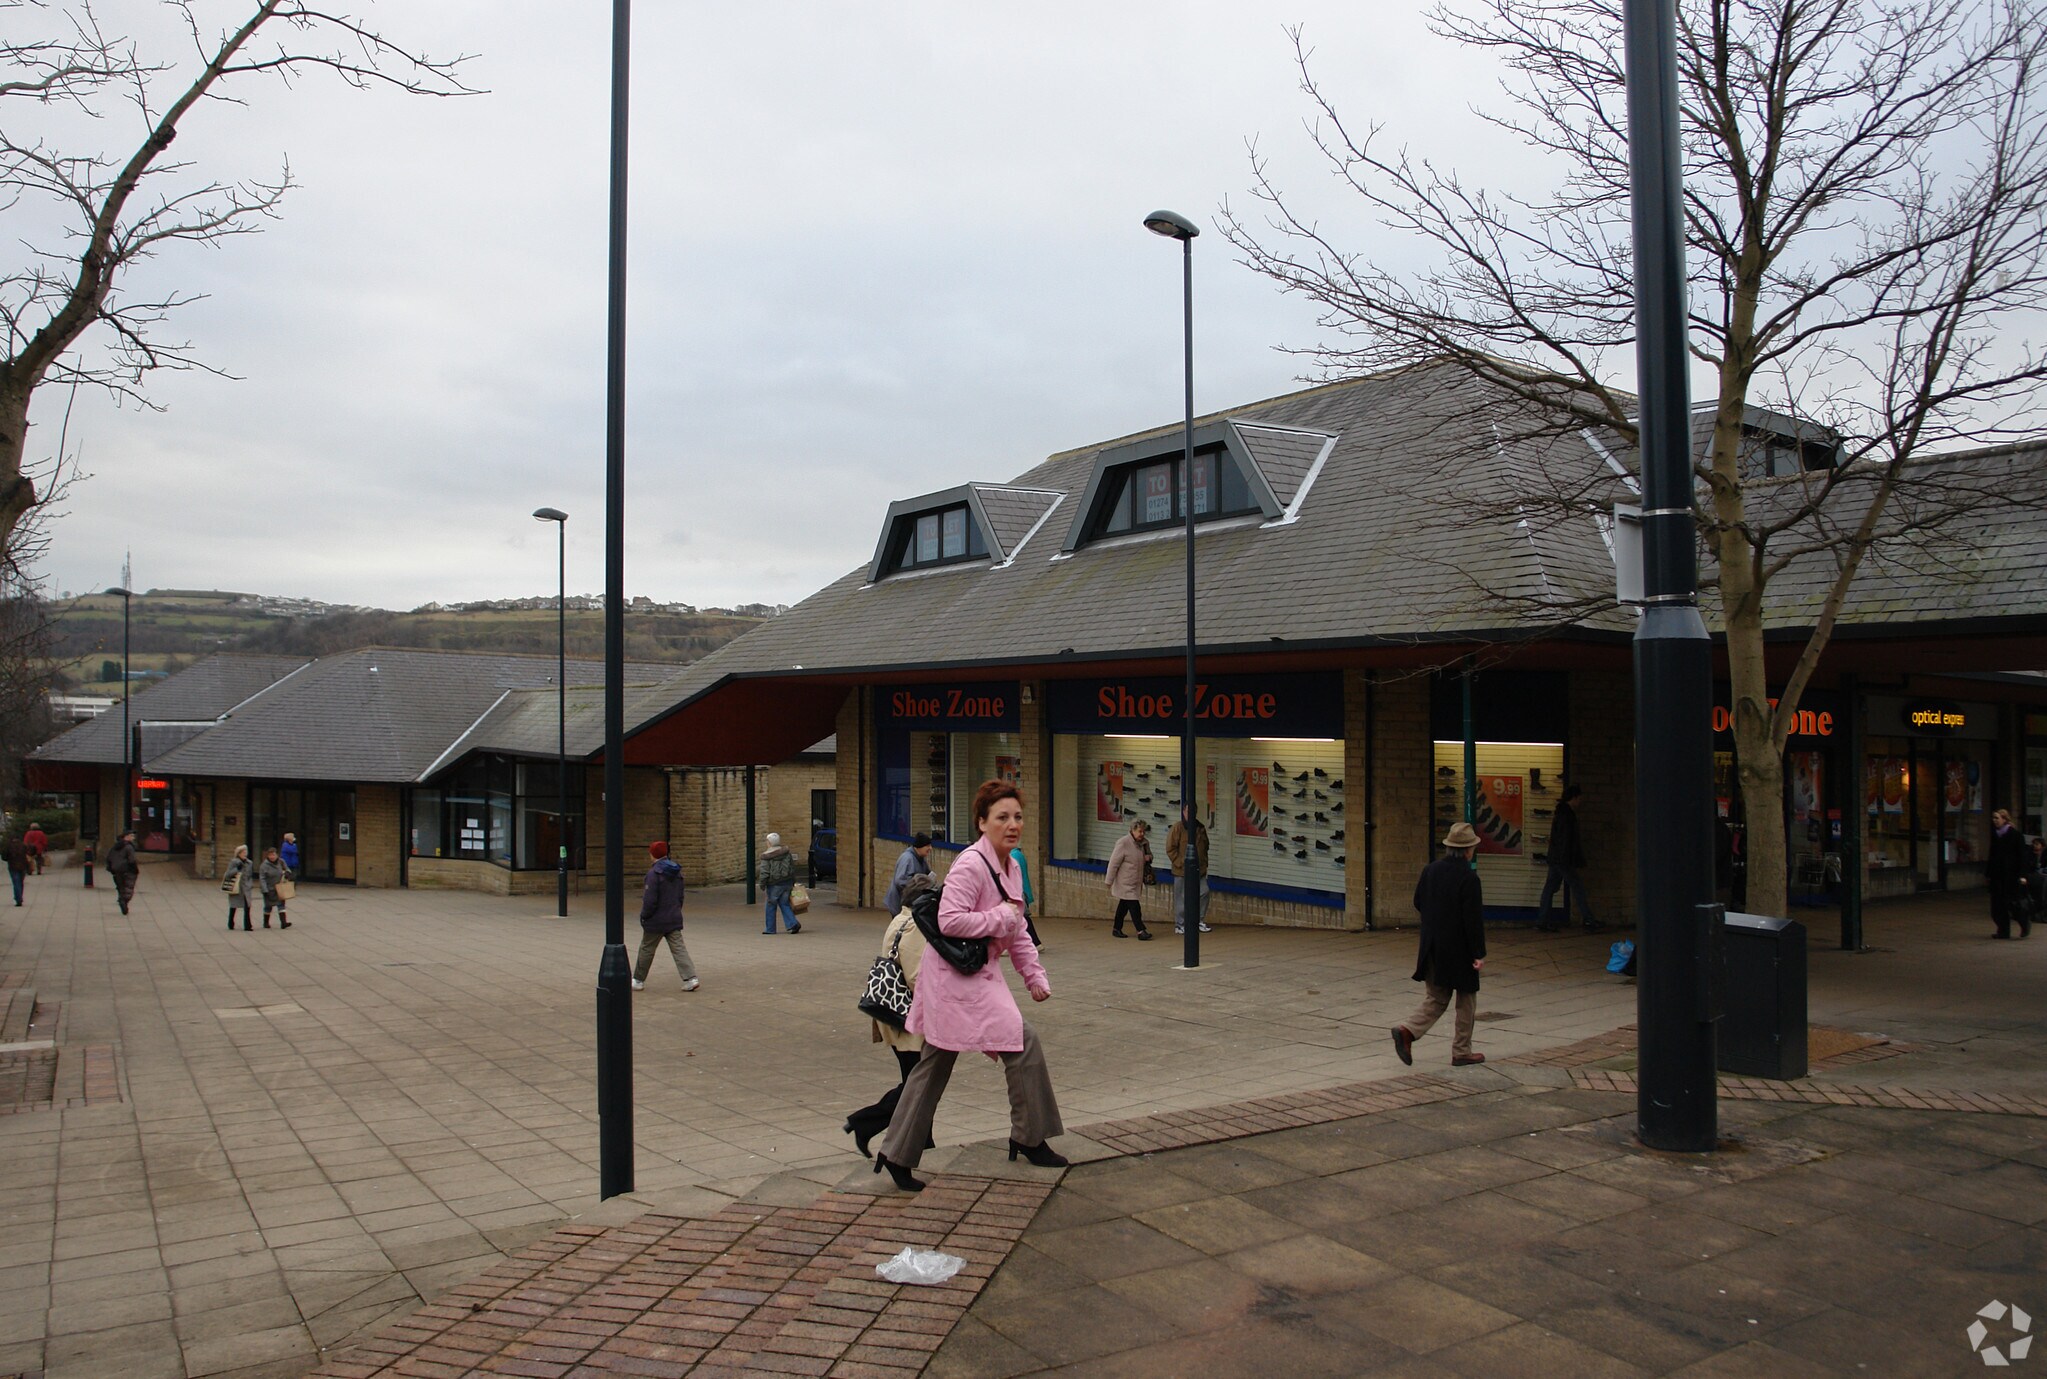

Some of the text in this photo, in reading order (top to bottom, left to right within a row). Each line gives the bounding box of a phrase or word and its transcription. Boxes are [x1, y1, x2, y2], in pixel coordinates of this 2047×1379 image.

[1149, 475, 1167, 493] TO
[892, 689, 1005, 718] Shoe Zone
[1098, 684, 1277, 719] Shoe Zone
[1911, 710, 1942, 727] optical
[1252, 769, 1268, 785] 9.99
[1493, 778, 1521, 796] 9.99
